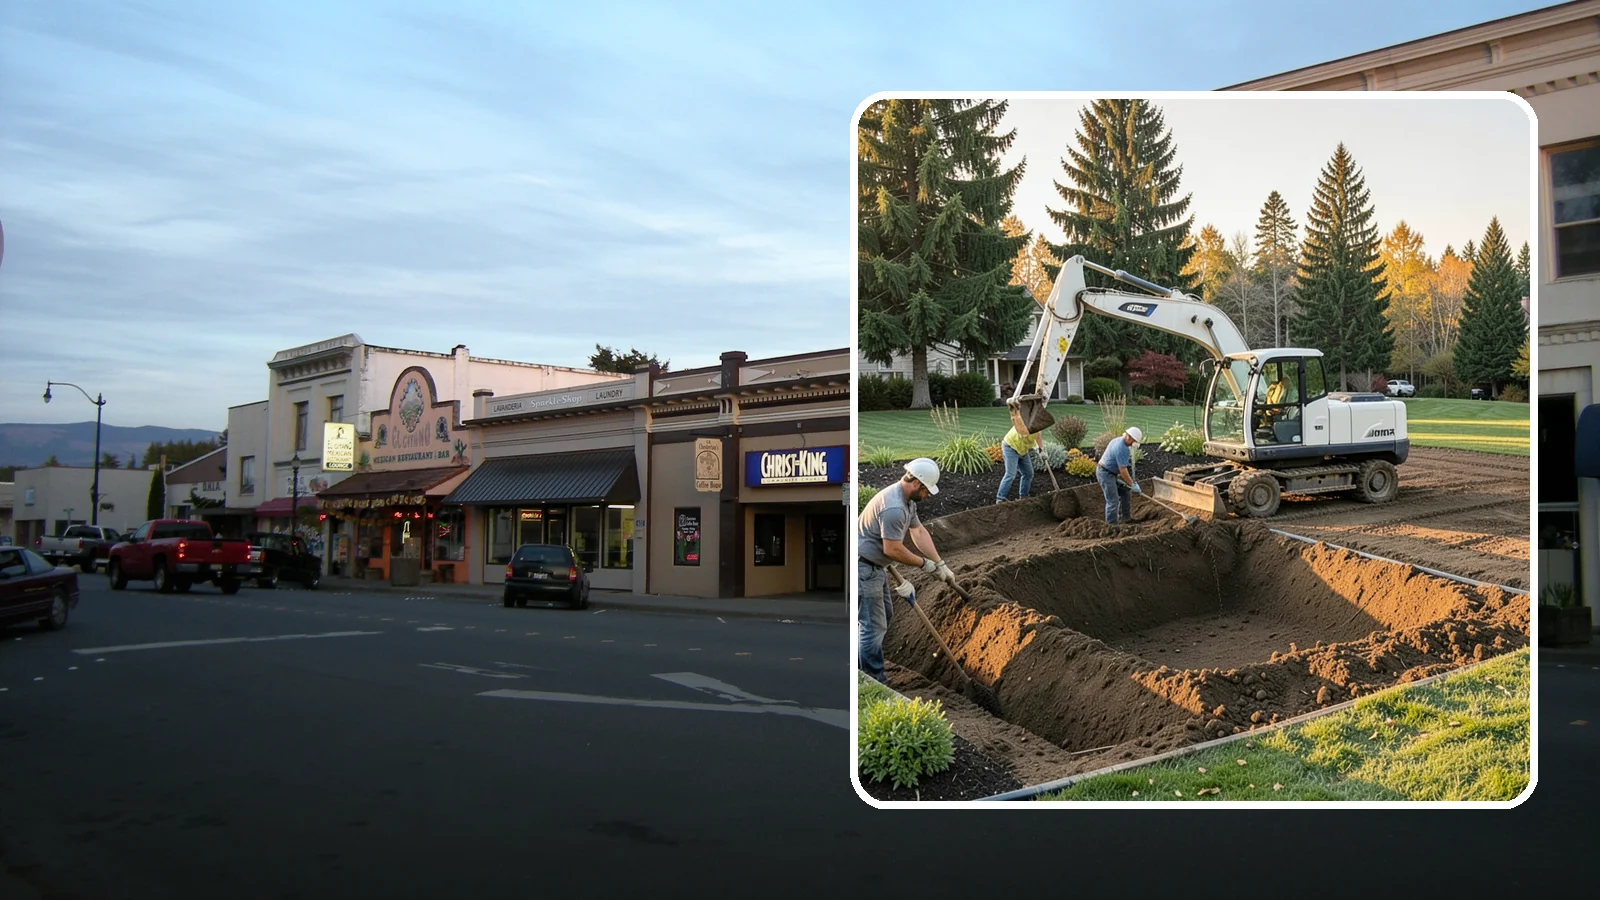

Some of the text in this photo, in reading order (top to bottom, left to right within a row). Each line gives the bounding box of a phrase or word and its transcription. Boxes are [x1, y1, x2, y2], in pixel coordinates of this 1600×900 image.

[494, 402, 523, 413] LAVANDERIA
[595, 389, 624, 400] LAUNDRY
[373, 454, 397, 464] MEXICAN
[398, 450, 433, 462] RESTAURANT
[438, 449, 450, 459] BAR
[761, 449, 827, 478] CHRIST KING
